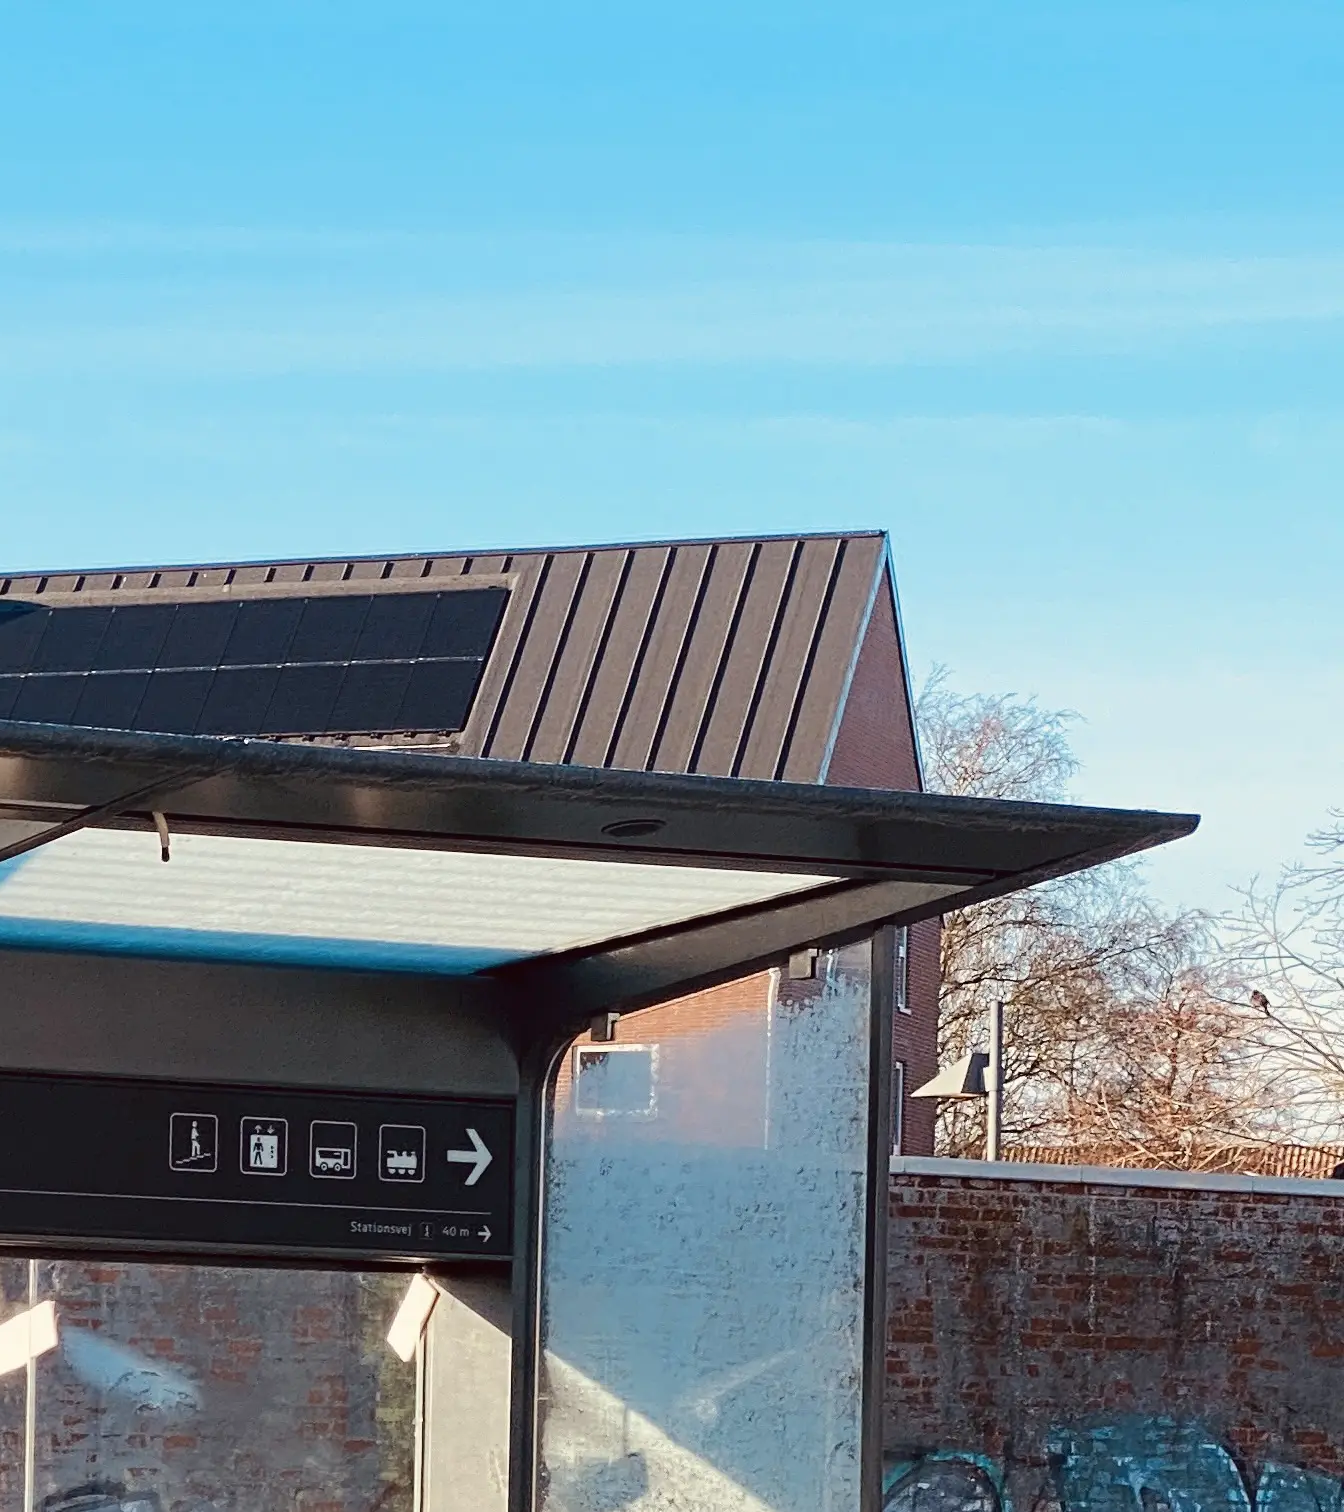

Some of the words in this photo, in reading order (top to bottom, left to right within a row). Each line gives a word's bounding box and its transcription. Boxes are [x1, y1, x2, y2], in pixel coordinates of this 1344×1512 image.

[350, 1220, 413, 1237] Stationsvej
[442, 1225, 457, 1237] 40
[459, 1227, 470, 1237] m
